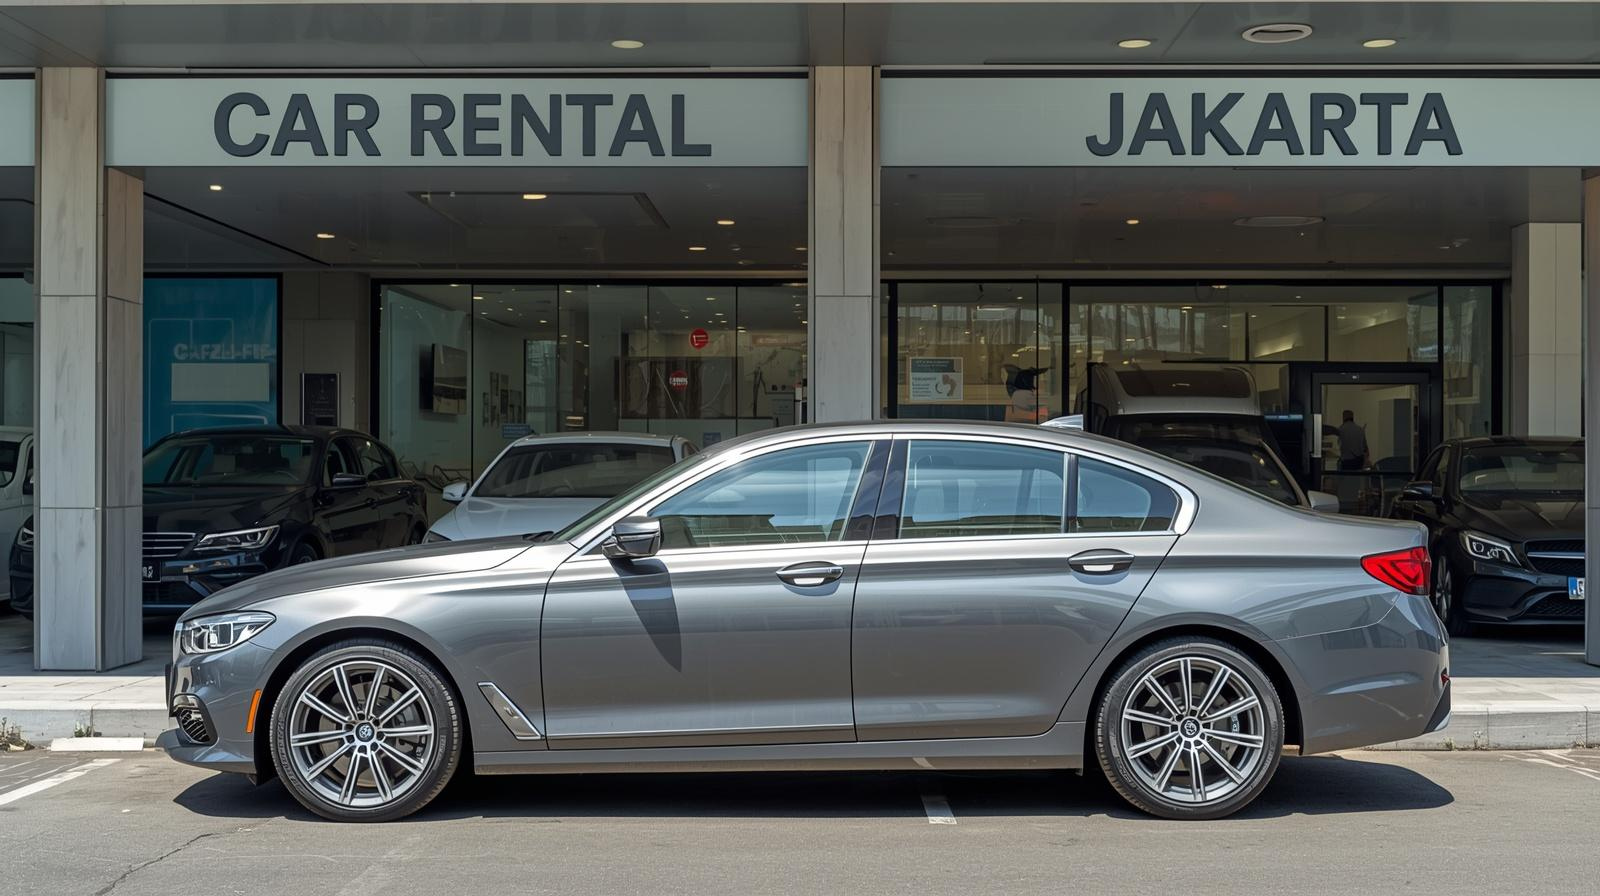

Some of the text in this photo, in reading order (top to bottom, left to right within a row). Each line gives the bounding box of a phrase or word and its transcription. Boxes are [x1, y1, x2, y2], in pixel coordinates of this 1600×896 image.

[214, 92, 712, 157] CAR RENTAL
[1086, 92, 1463, 157] JAKARTA
